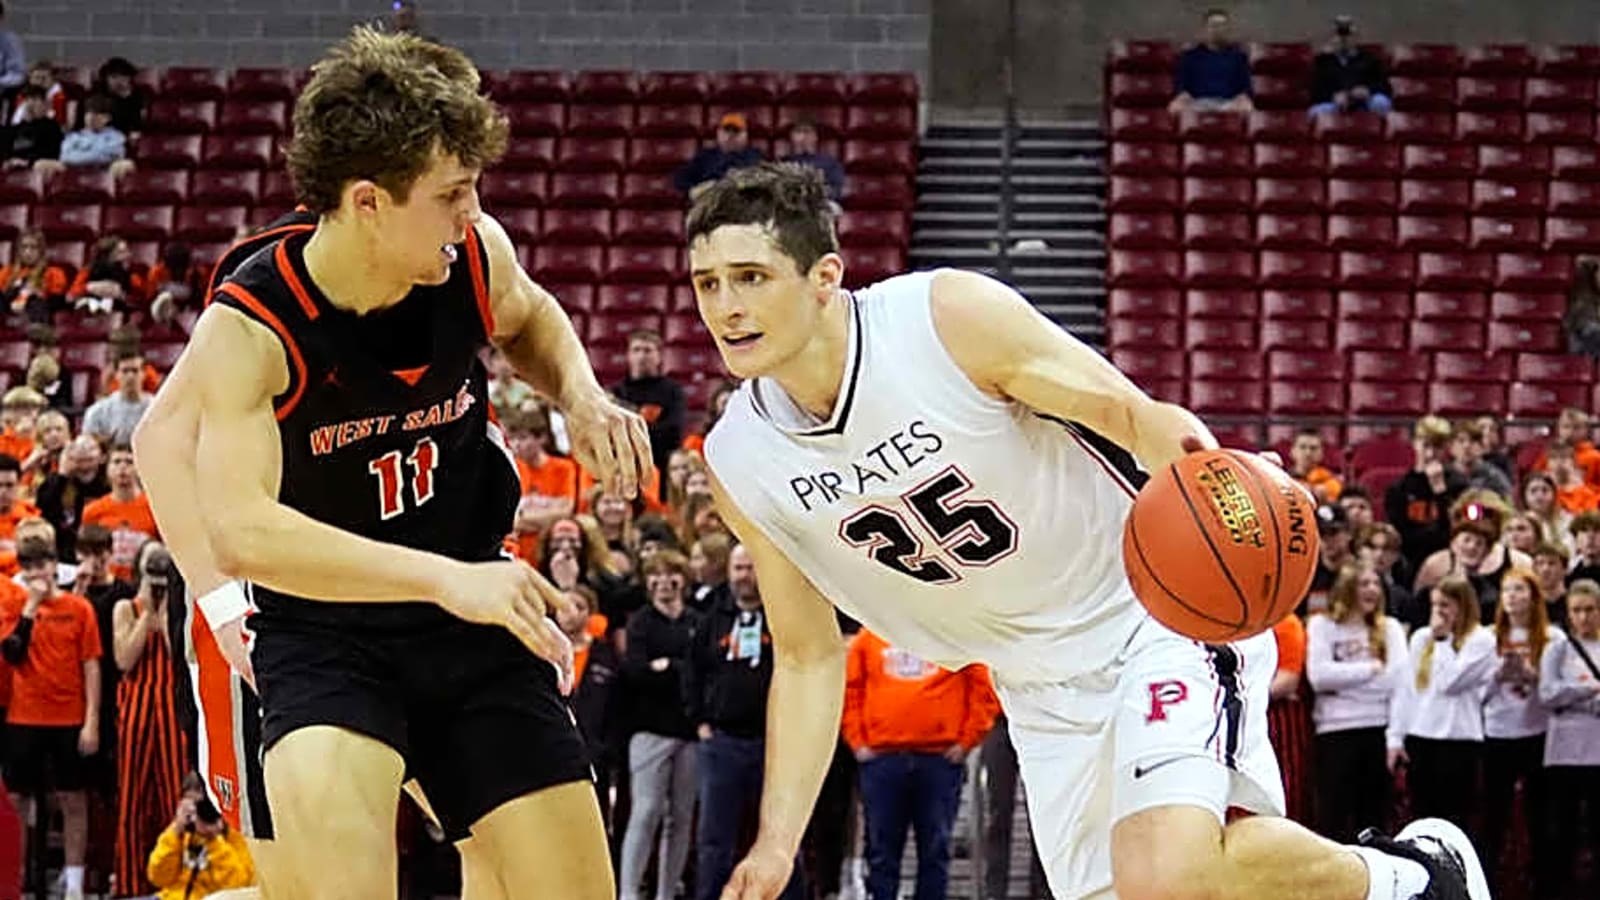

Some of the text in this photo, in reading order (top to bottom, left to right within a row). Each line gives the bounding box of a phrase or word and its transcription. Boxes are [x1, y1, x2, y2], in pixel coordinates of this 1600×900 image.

[310, 415, 396, 455] WEST
[790, 420, 943, 512] PIRATES
[368, 436, 438, 520] 11
[838, 464, 1019, 585] 25
[1146, 680, 1188, 723] P
